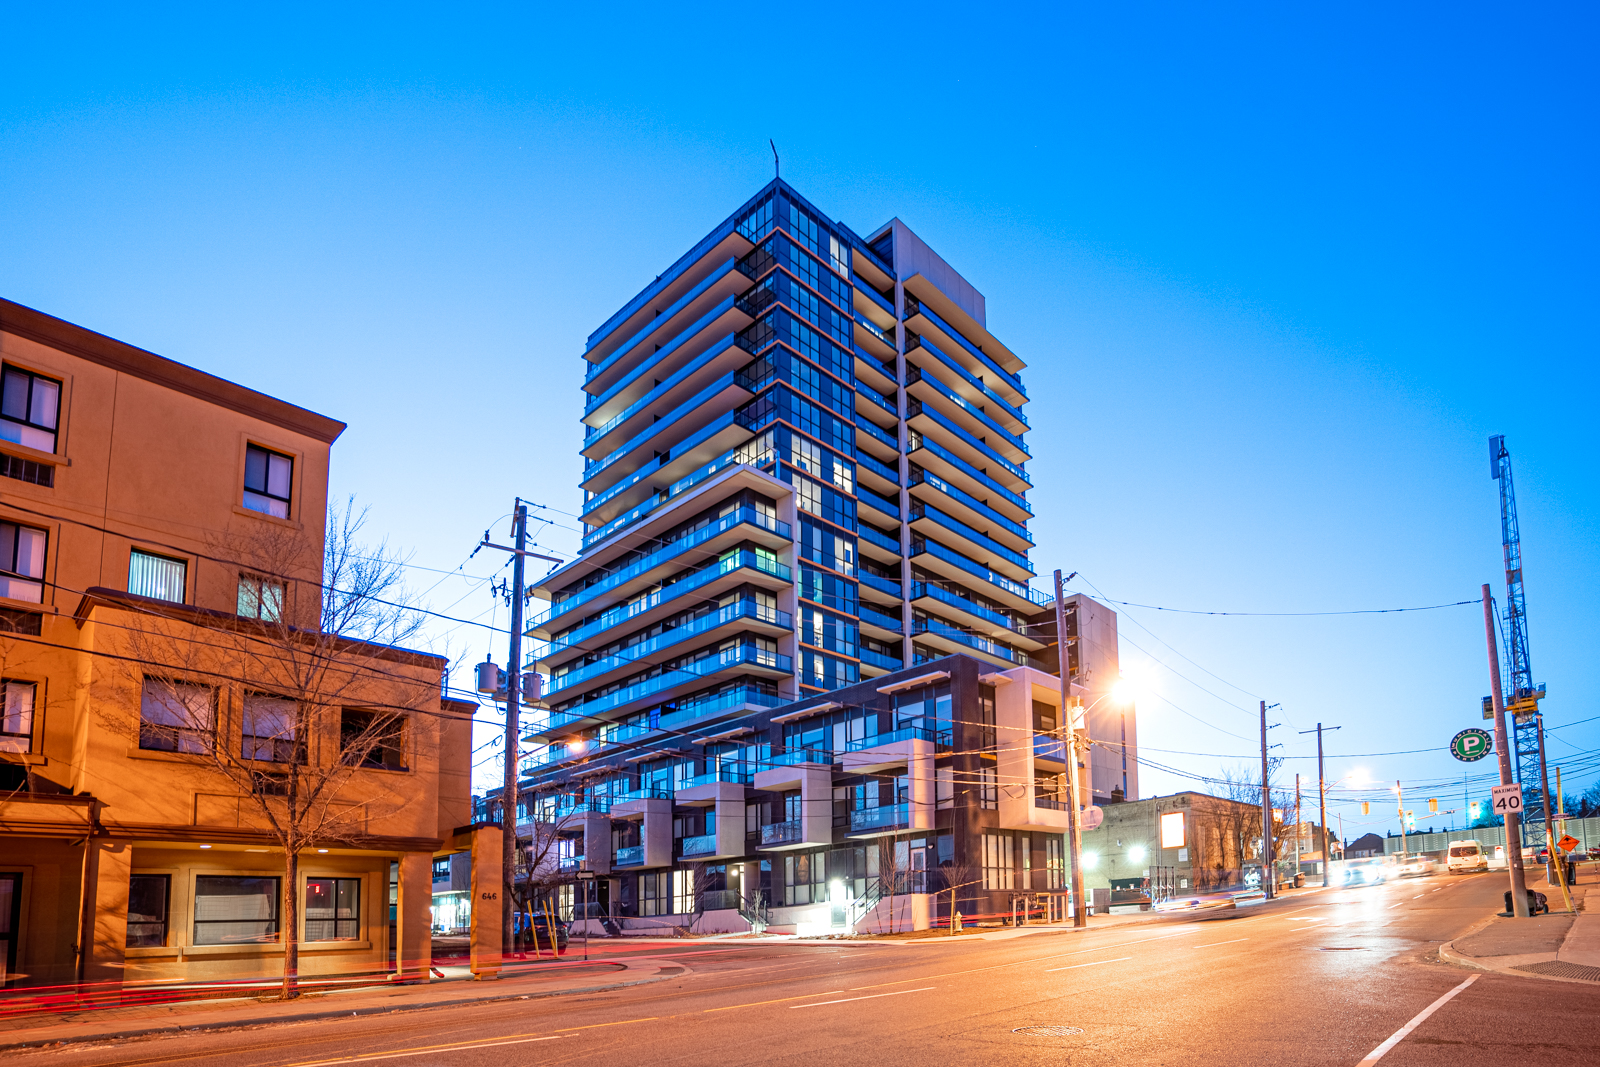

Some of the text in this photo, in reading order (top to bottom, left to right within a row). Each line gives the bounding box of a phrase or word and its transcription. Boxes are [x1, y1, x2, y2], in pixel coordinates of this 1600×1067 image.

[1451, 729, 1490, 748] MUNICIPAL
[1463, 736, 1480, 751] P
[1452, 744, 1491, 761] PARKING
[1493, 786, 1519, 794] MAXIMUM
[1496, 795, 1520, 810] 40
[482, 892, 497, 900] 646
